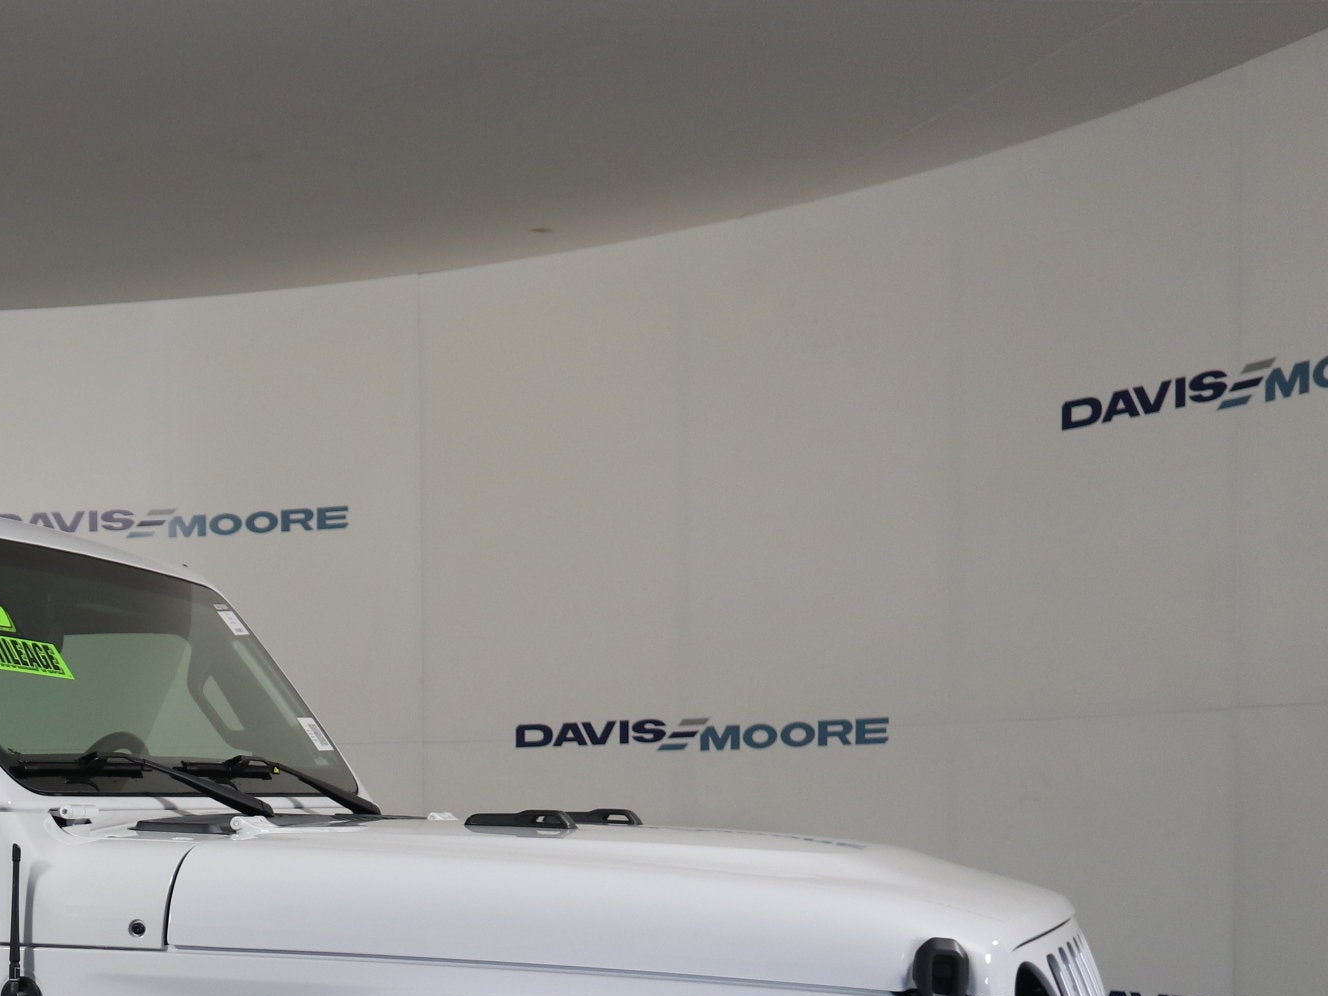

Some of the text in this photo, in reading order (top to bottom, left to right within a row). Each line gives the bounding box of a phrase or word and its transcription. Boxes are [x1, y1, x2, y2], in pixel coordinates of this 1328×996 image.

[1061, 370, 1227, 431] DAVIS
[168, 505, 350, 537] MOORE
[515, 716, 890, 752] DAVIS MOORE
